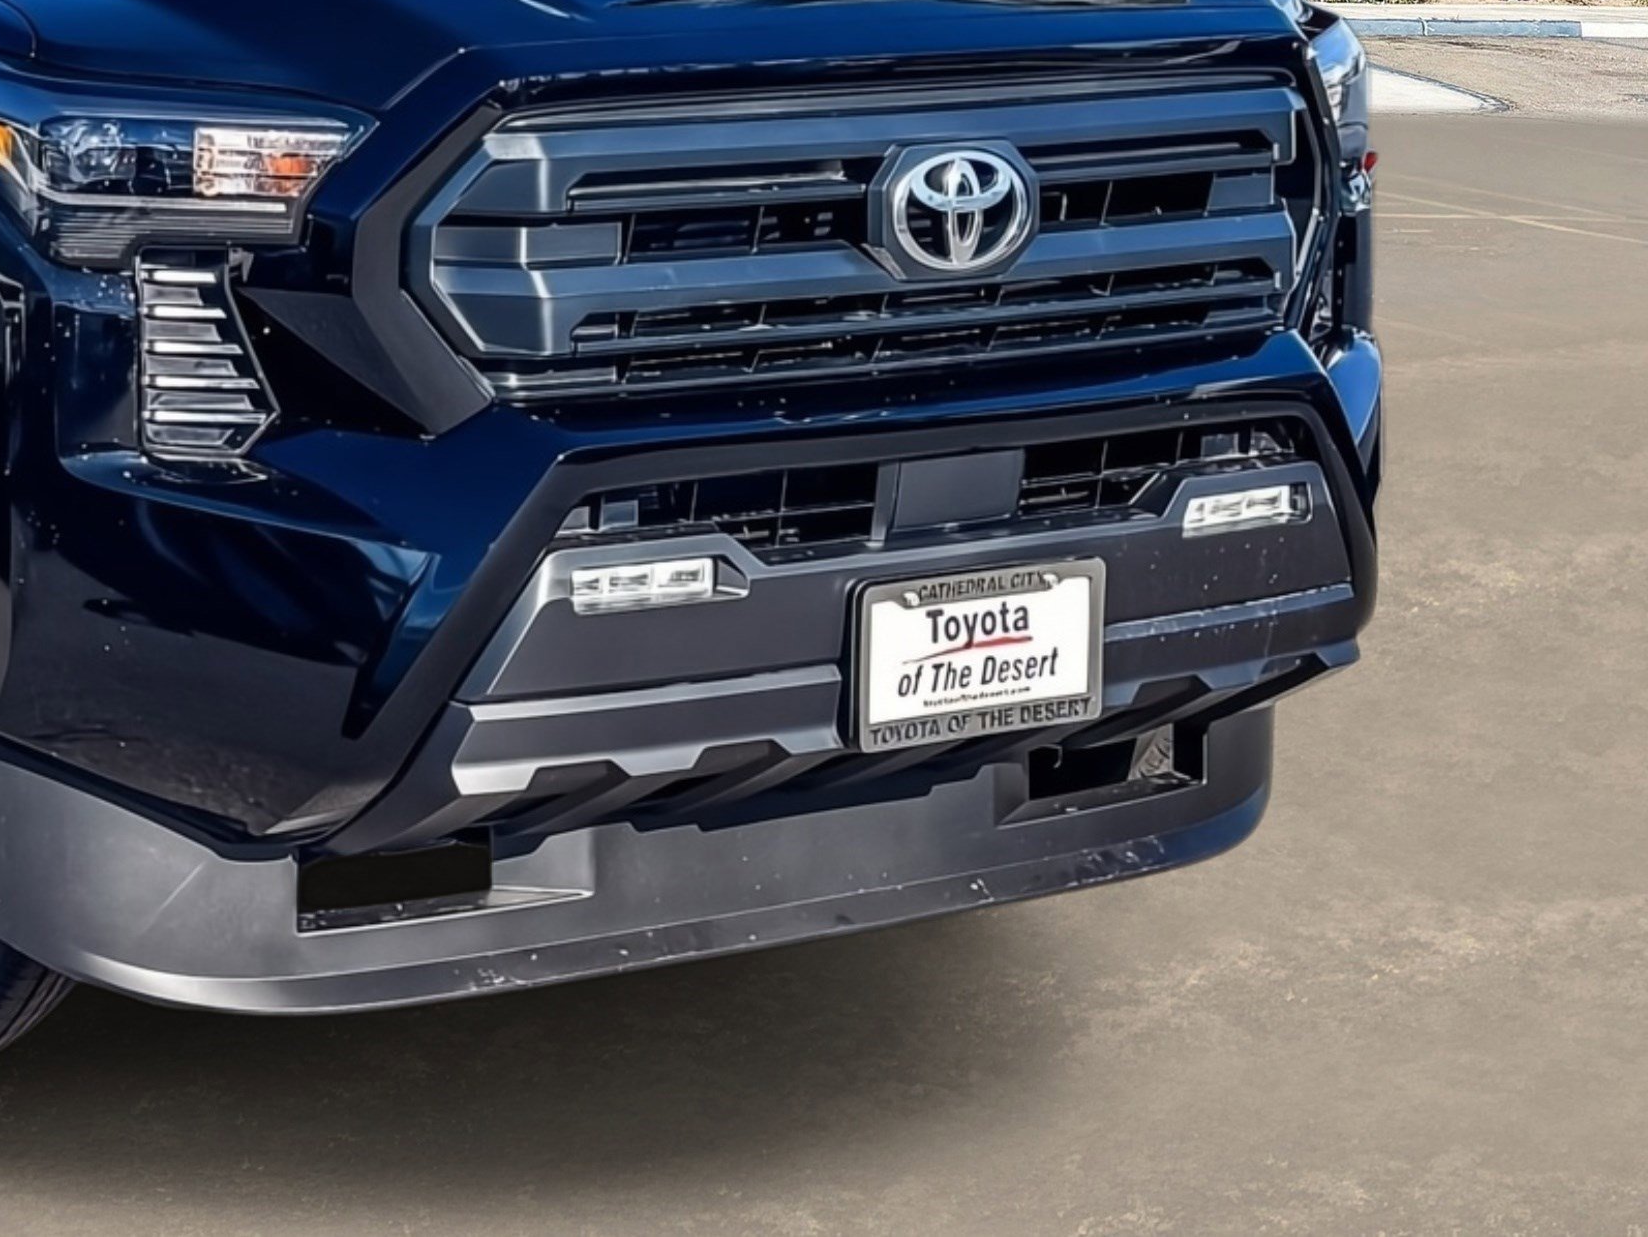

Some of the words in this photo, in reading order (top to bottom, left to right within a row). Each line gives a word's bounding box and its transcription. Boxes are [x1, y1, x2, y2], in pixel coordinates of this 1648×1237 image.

[918, 575, 1007, 601] CATHEDRAL
[925, 601, 1029, 649] Toyota
[897, 665, 923, 697] of
[930, 661, 972, 694] The
[981, 647, 1059, 686] Desert
[870, 719, 941, 746] TOYOTA
[947, 715, 971, 733] OF
[977, 706, 1014, 730] THE
[1020, 696, 1092, 724] DESERT
